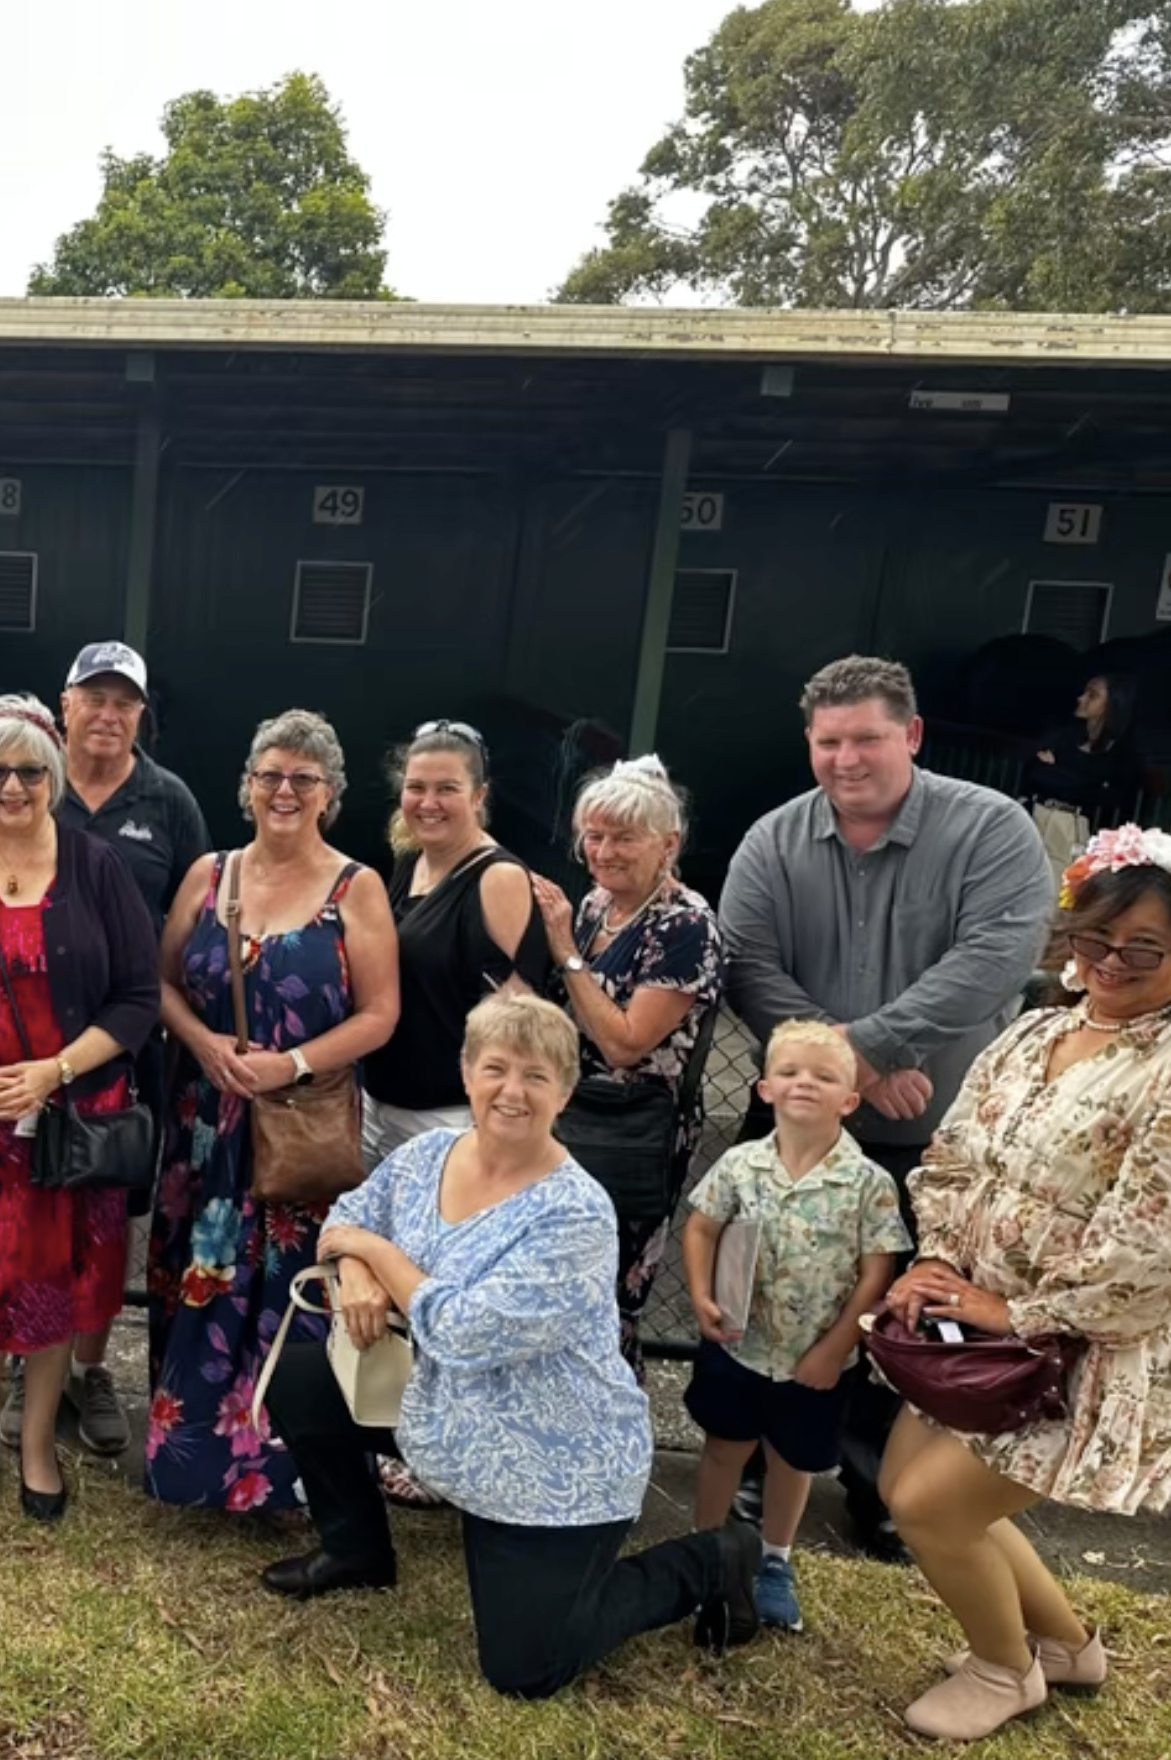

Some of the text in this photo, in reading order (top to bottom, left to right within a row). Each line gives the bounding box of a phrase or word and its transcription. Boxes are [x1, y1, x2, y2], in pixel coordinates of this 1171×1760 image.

[318, 491, 359, 519] 49
[680, 497, 717, 524] 50
[1057, 509, 1090, 537] 51
